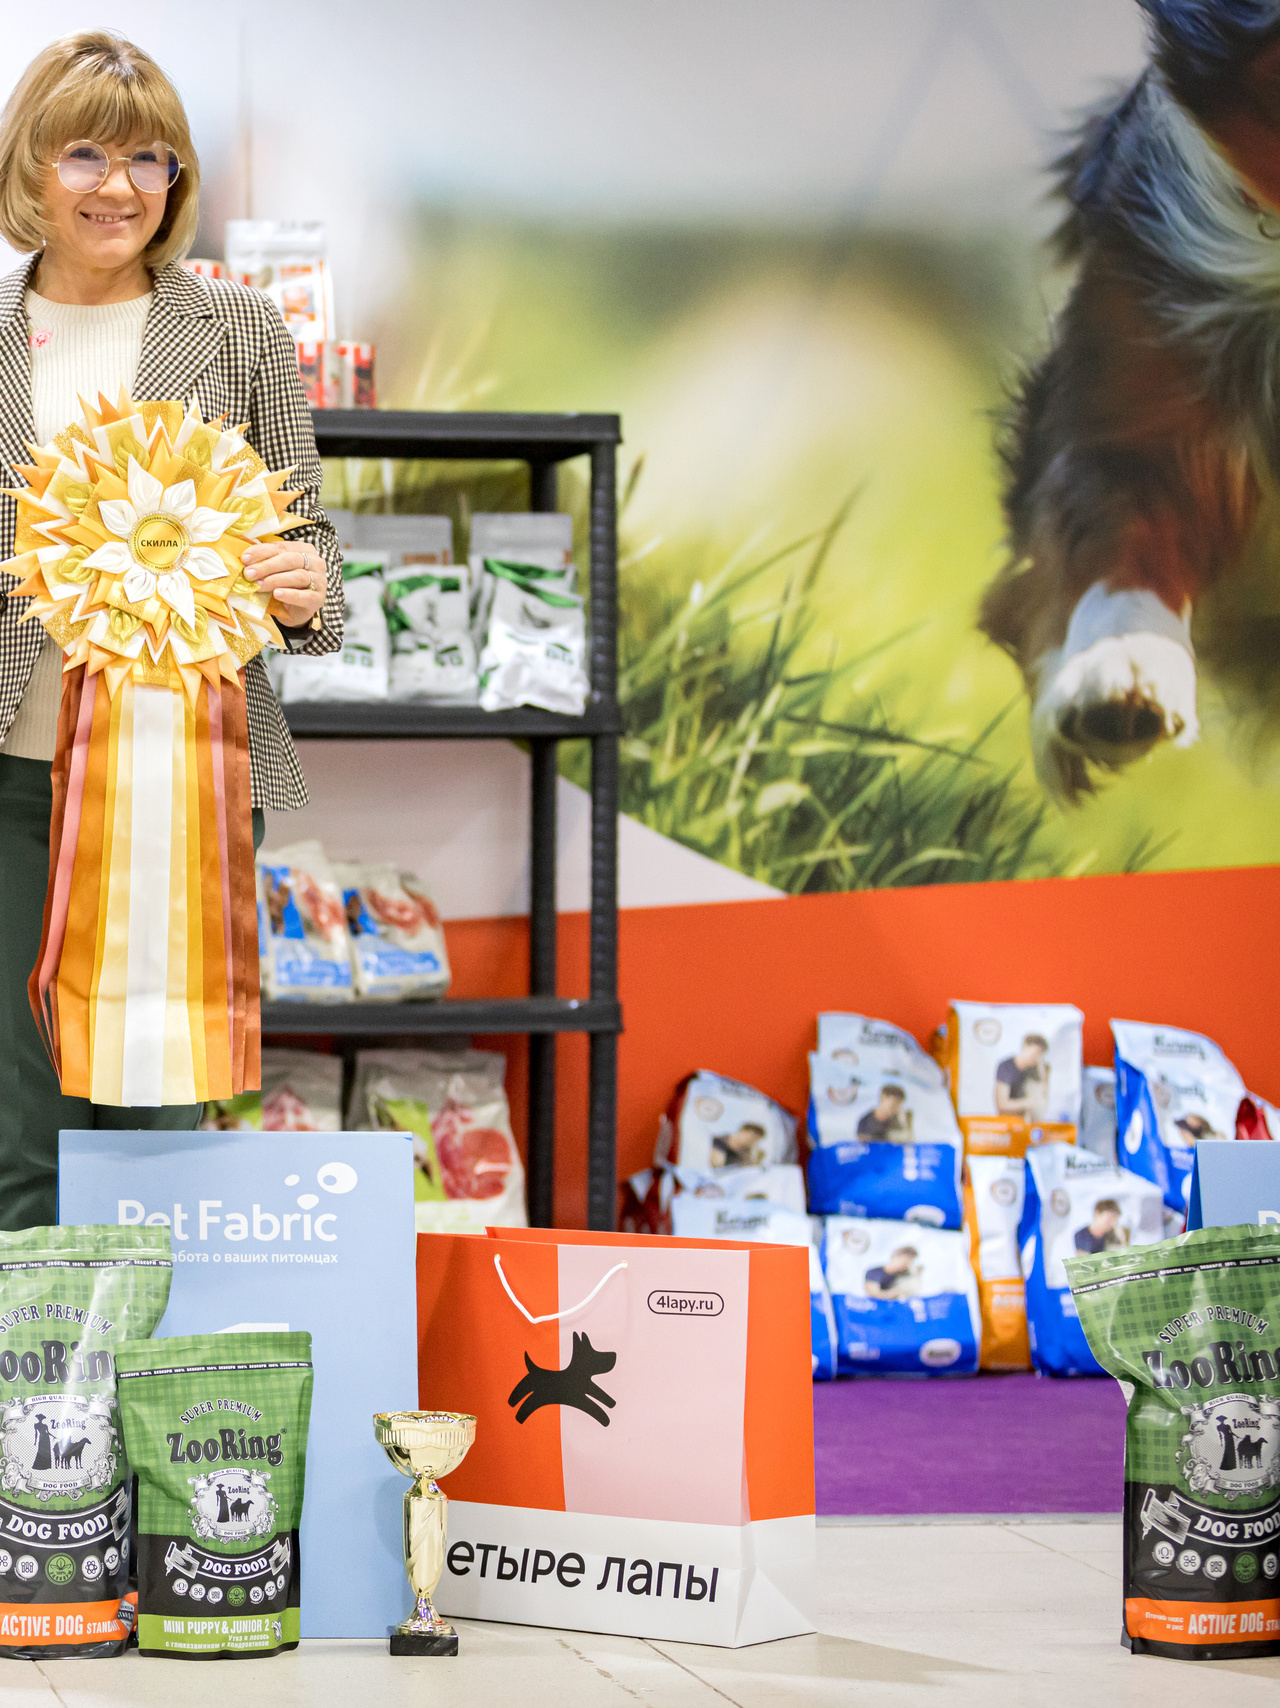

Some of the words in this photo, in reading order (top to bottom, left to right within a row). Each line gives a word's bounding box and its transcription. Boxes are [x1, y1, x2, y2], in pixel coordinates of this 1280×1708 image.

[198, 1199, 338, 1242] Fabric
[212, 1252, 222, 1264] о
[226, 1252, 269, 1264] ваших
[271, 1252, 338, 1266] питомцах
[656, 1295, 714, 1312] 4lapy.ru
[45, 1303, 114, 1336] PREMIUM
[1158, 1311, 1204, 1344] SUPER
[1206, 1305, 1269, 1335] PREMIUM
[1141, 1341, 1280, 1390] ZooRin
[179, 1400, 215, 1424] SUPER
[216, 1398, 263, 1422] PREMIUM
[1208, 1397, 1224, 1406] HIGH
[59, 1481, 78, 1489] FOOD
[6, 1514, 52, 1540] DOG
[57, 1513, 109, 1540] FOOD
[1194, 1514, 1239, 1539] DOG
[201, 1558, 232, 1575] DOG
[234, 1557, 268, 1575] FOOD
[446, 1540, 586, 1588] етыре
[596, 1556, 719, 1603] лапы
[0, 1614, 50, 1637] ACTIVE
[55, 1614, 84, 1636] DOG
[163, 1620, 185, 1634] MINI
[187, 1621, 220, 1635] PUPPY
[221, 1620, 229, 1635] &
[230, 1619, 262, 1634] JUNIOR
[264, 1618, 270, 1632] 2
[1188, 1613, 1237, 1635] ACTIVE
[1239, 1612, 1265, 1633] DOG
[171, 1642, 220, 1650] глюкозамином
